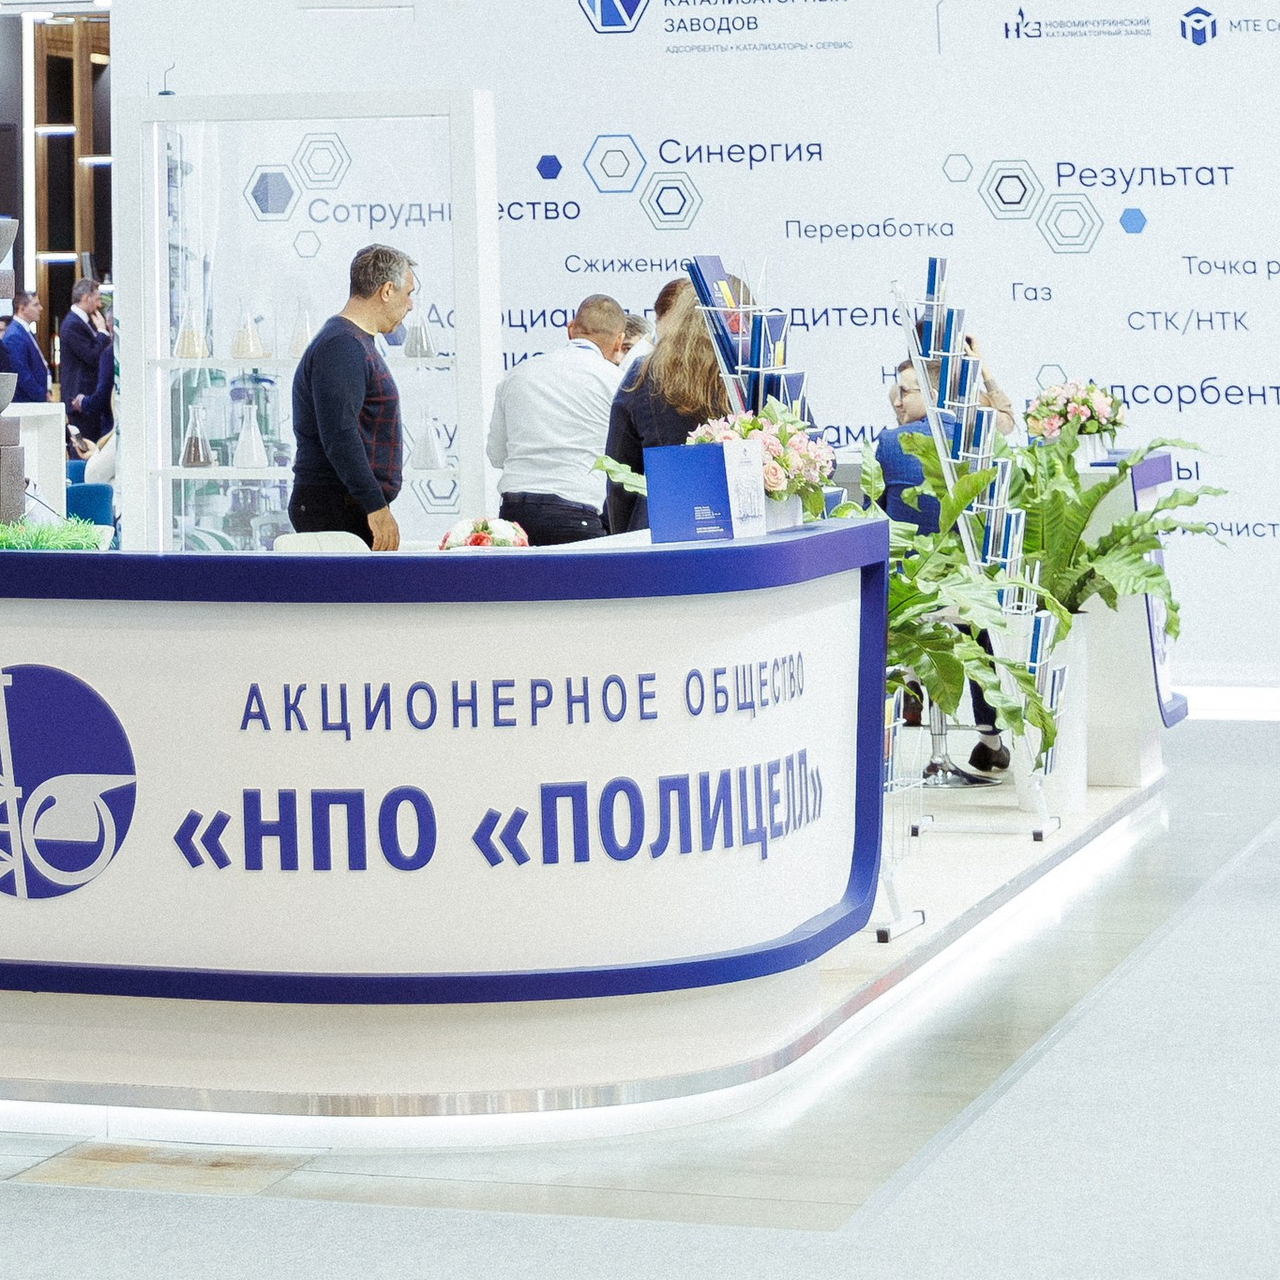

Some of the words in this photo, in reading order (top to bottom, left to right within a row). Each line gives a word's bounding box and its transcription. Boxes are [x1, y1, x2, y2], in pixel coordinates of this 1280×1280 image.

[664, 16, 759, 35] ЗАВОДОВ
[658, 138, 824, 170] Синергия
[1056, 161, 1236, 195] Результат
[785, 217, 955, 243] Переработка
[564, 254, 692, 273] Сжижение
[1182, 255, 1258, 275] Точка
[1011, 282, 1053, 303] Газ
[1127, 309, 1249, 335] СТК/НТК
[239, 673, 658, 742] АКЦИОНЕРНОЕ
[684, 650, 804, 718] ОБЩЕСТВО
[173, 786, 437, 872] «НПО
[471, 748, 823, 869] «ПОЛИЦЕЛЛ»
